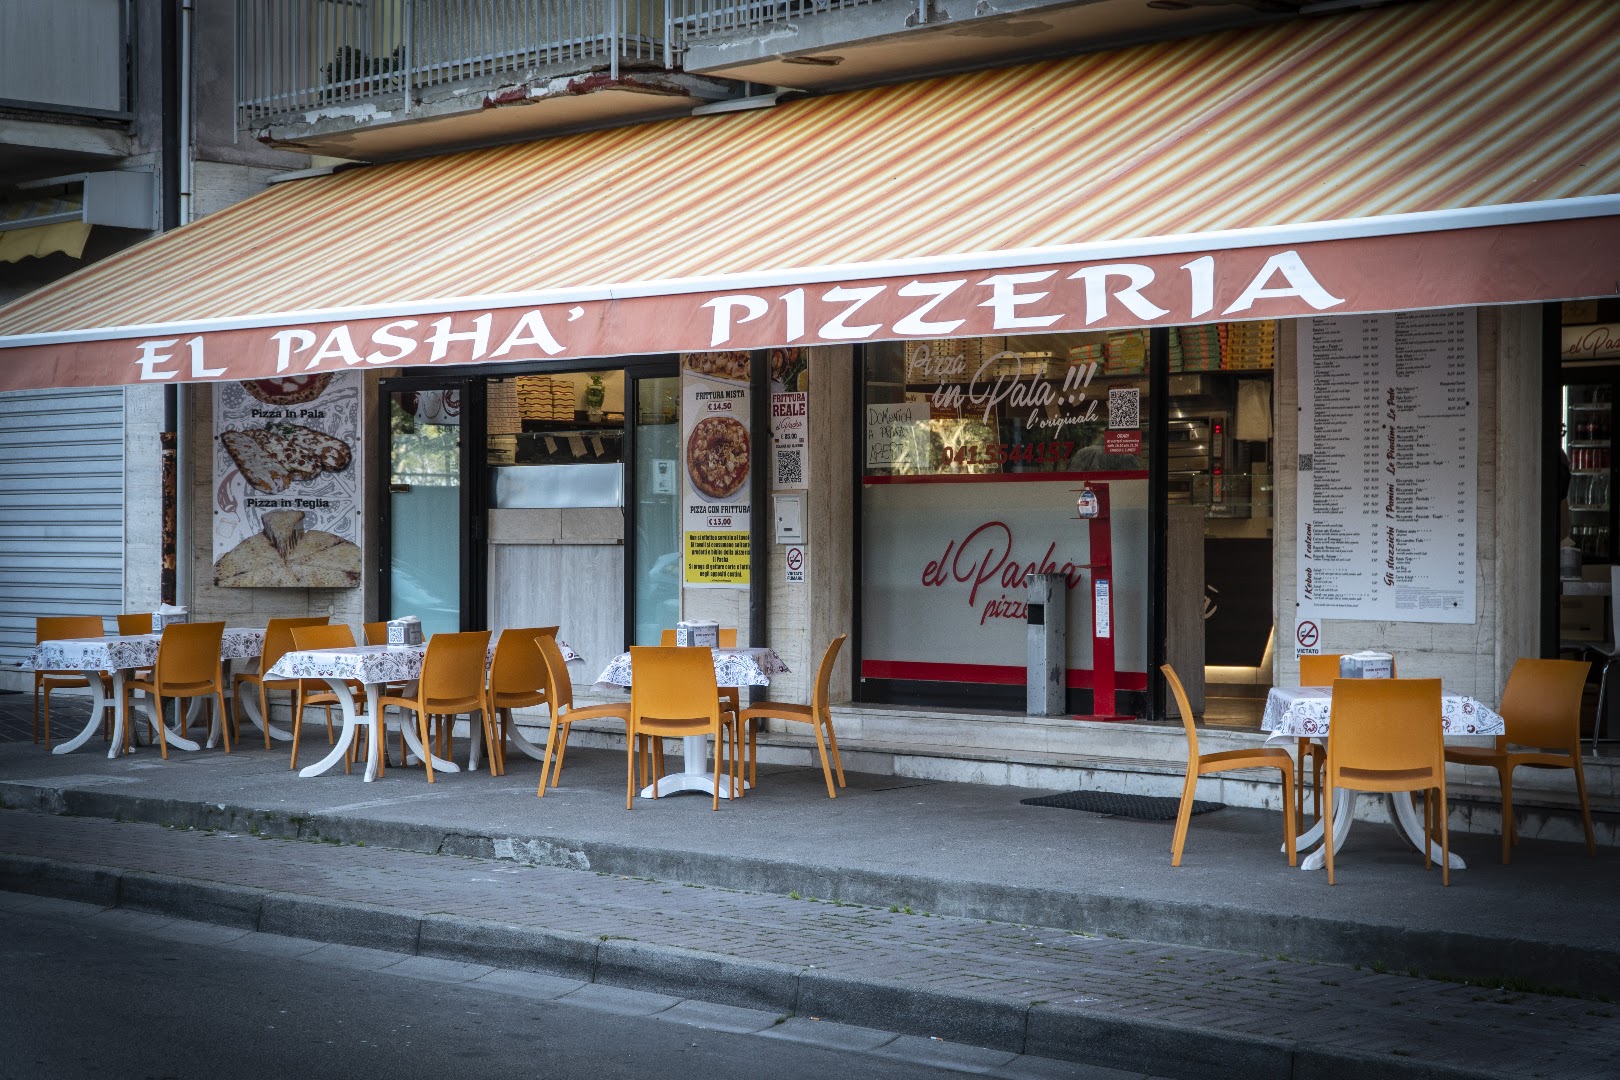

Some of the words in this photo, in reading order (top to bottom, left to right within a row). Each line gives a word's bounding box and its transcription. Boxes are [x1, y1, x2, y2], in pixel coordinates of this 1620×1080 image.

[135, 335, 228, 380] EL
[270, 305, 586, 373] PASHA'
[700, 251, 1345, 347] PIZZERIA
[1569, 336, 1582, 354] el
[907, 344, 966, 379] Pizza
[696, 391, 725, 401] FRITTURA
[726, 389, 745, 399] MISTA
[773, 393, 806, 403] FRITTURA
[931, 381, 965, 409] in
[969, 351, 1097, 425] Pala!!!
[1386, 387, 1395, 407] Pale
[252, 409, 282, 418] Pizza
[286, 409, 297, 418] In
[300, 408, 324, 418] Pala
[773, 403, 806, 417] REALE
[1026, 400, 1099, 440] l'originale
[1386, 408, 1396, 422] Le
[868, 429, 874, 440] A
[1386, 425, 1395, 460] Piadine
[941, 441, 1075, 466] 041.5544157
[1386, 462, 1396, 476] Le
[247, 498, 280, 508] Pizza
[281, 498, 292, 508] in
[295, 498, 330, 510] Teglia
[1386, 483, 1395, 513] Panini
[690, 505, 707, 514] PIZZA
[708, 505, 720, 513] CON
[721, 505, 750, 513] FRITTURA
[1304, 522, 1312, 553] calzoni
[1385, 525, 1395, 570] stuzzichi
[922, 540, 954, 587] el
[1304, 567, 1313, 594] Kebab
[1383, 571, 1395, 587] Gli
[980, 594, 1028, 625] pizze
